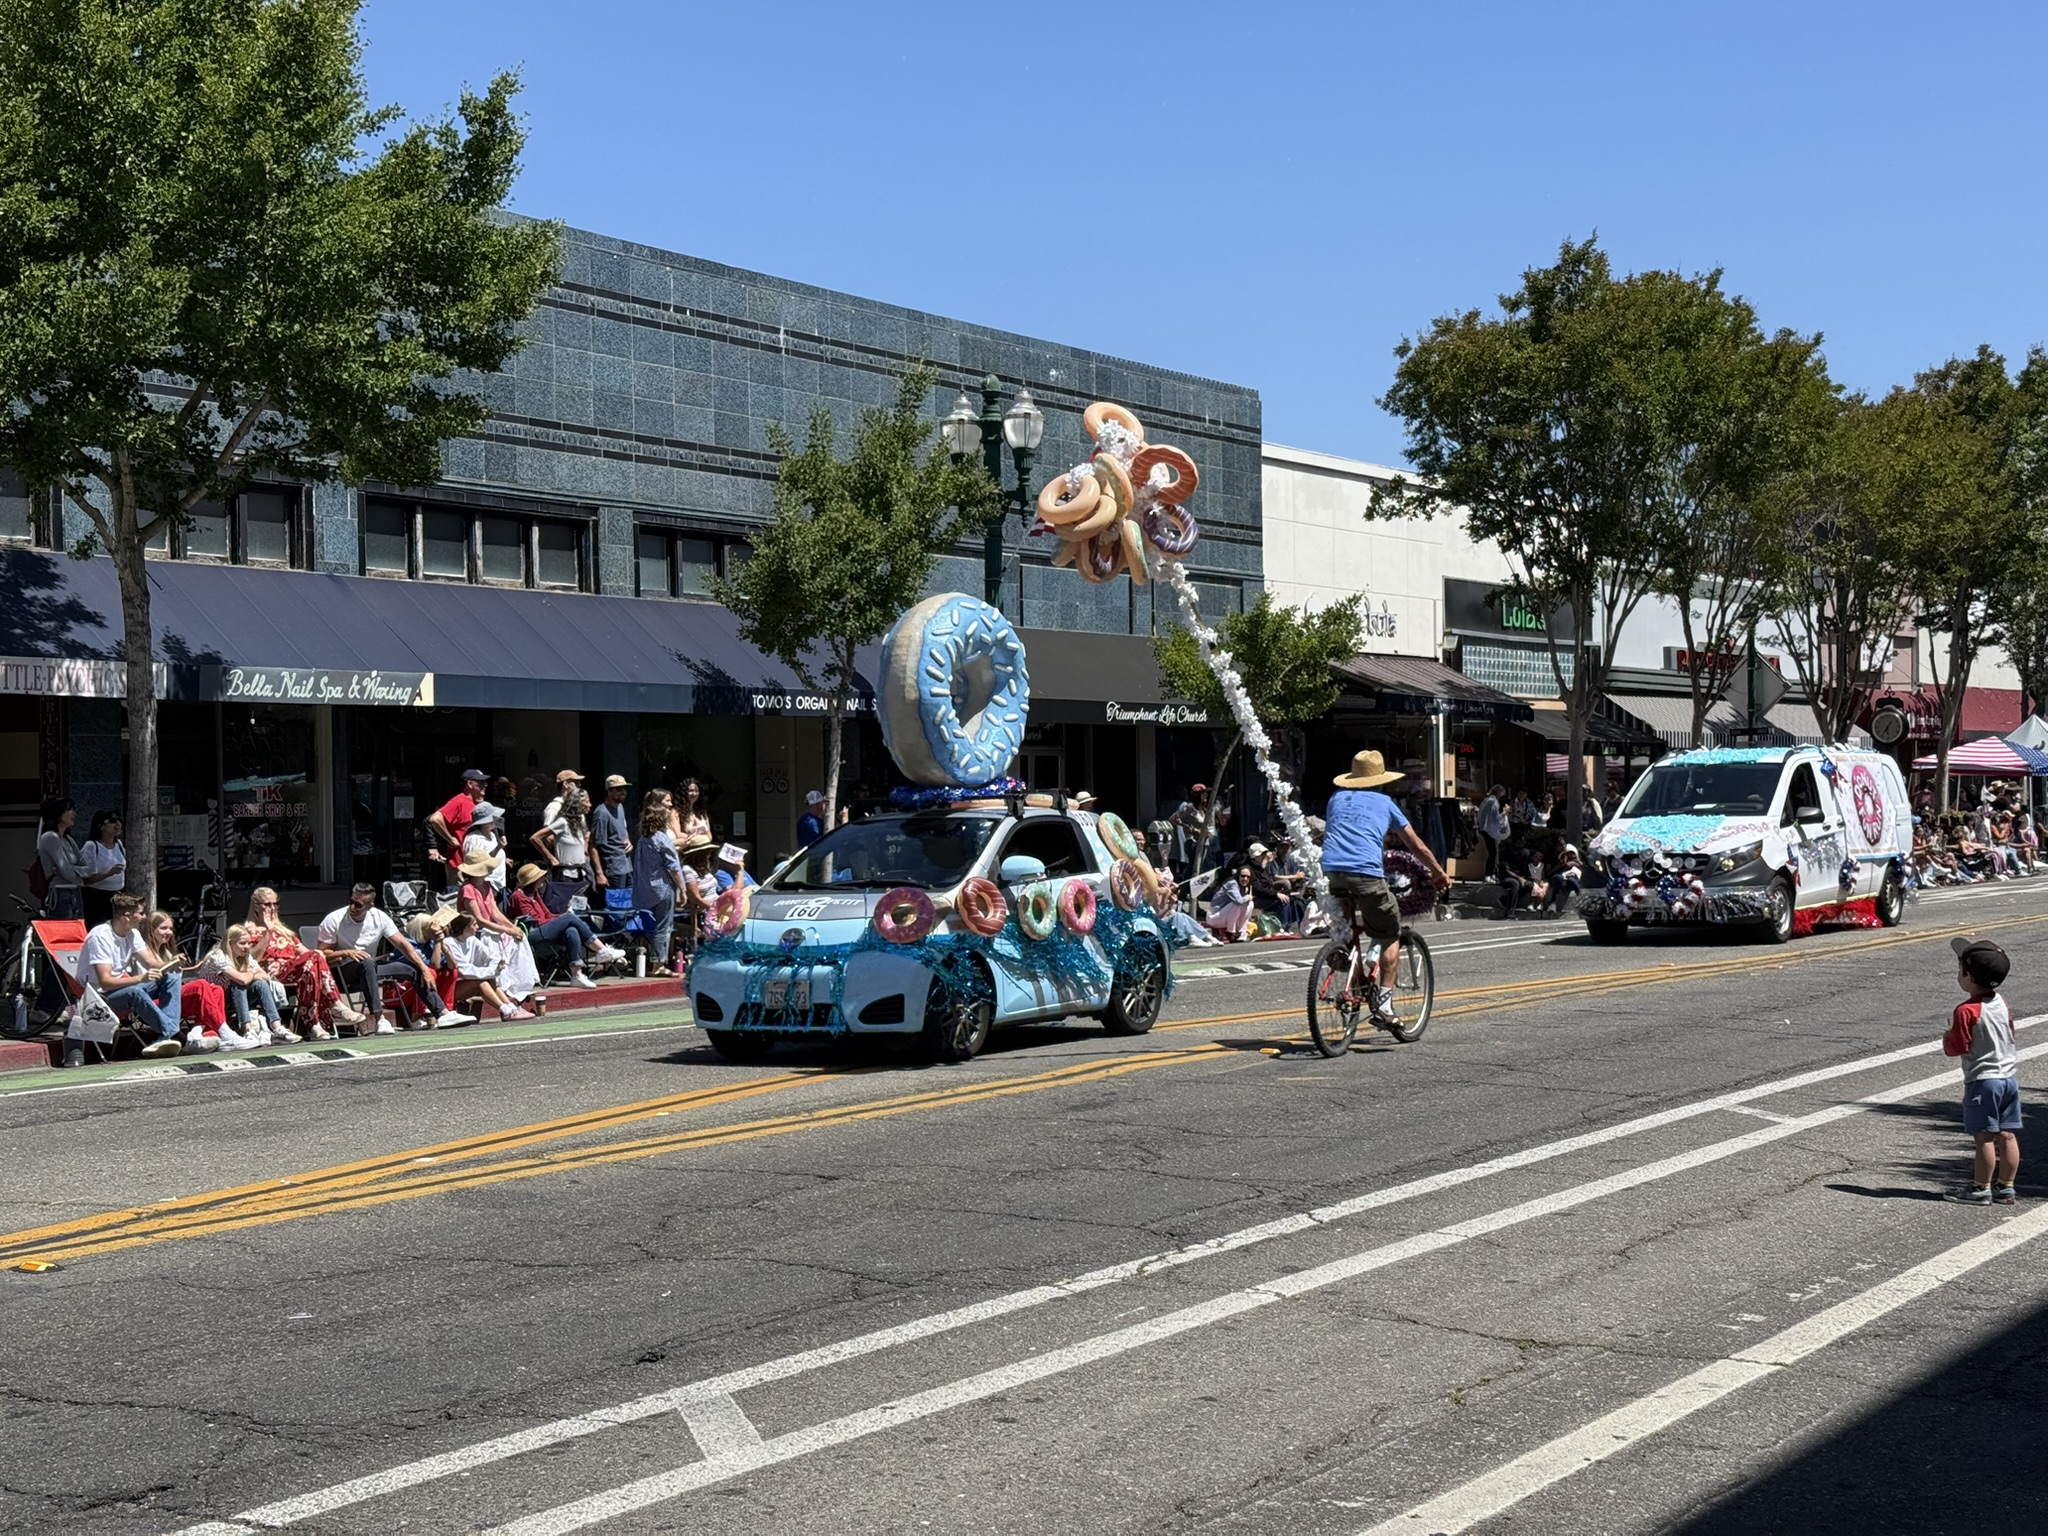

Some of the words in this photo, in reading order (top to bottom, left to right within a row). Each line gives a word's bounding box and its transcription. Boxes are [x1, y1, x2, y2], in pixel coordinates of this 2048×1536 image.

[226, 669, 274, 697] Bella
[275, 671, 314, 699] Nail
[316, 676, 344, 703] Spa
[348, 675, 361, 699] &
[362, 673, 412, 705] Waxing
[752, 694, 792, 710] TOMO'S
[796, 695, 842, 711] ORGA
[846, 697, 867, 711] NAIL
[1106, 701, 1159, 725] Triumphant
[1159, 704, 1176, 726] Life
[1177, 705, 1207, 723] Church
[253, 783, 284, 802] TK
[233, 803, 264, 817] BARBER
[265, 803, 285, 817] SHOP
[294, 803, 309, 817] SPA
[788, 906, 821, 918] 160
